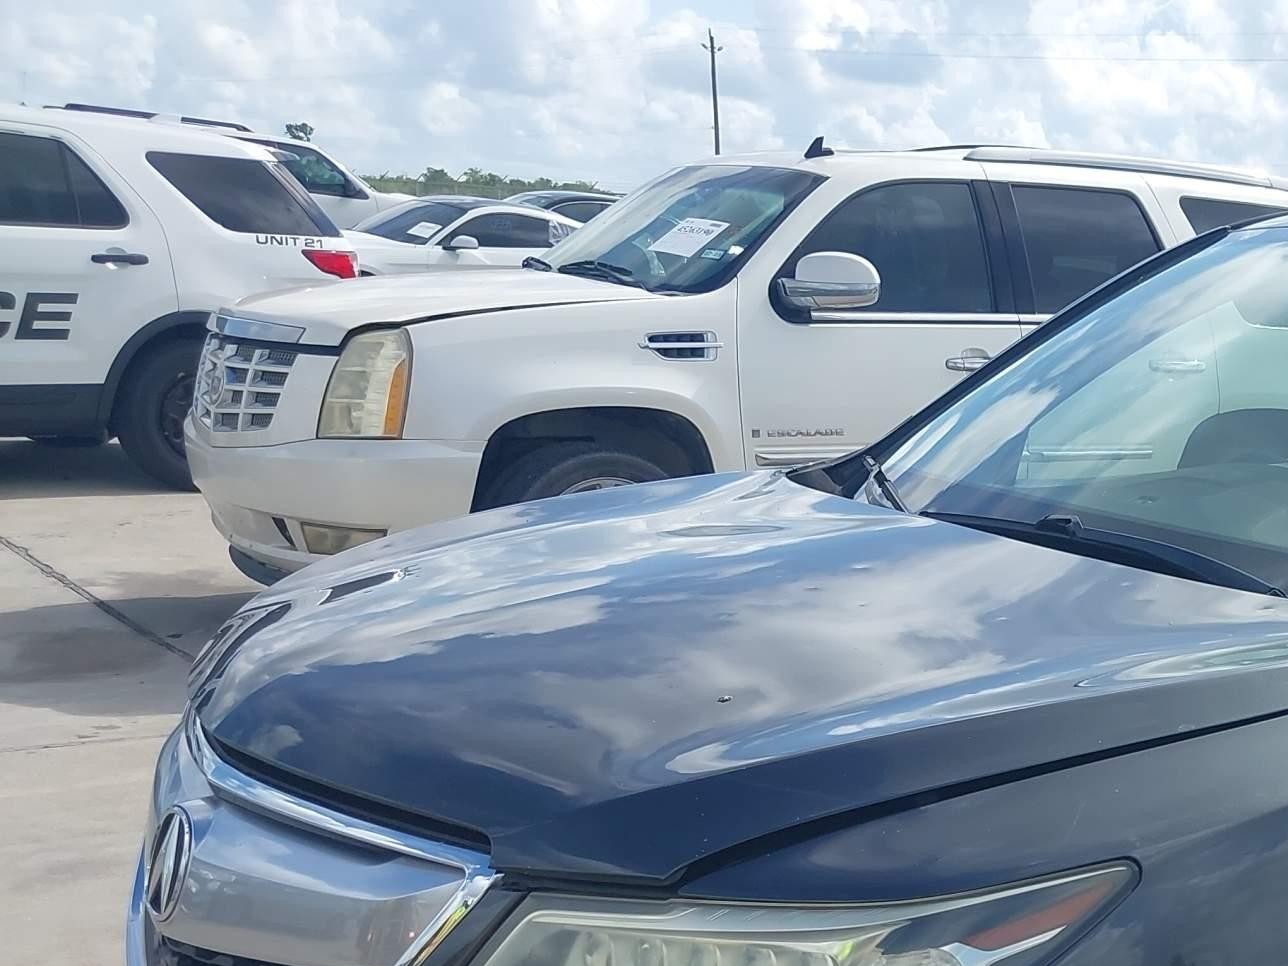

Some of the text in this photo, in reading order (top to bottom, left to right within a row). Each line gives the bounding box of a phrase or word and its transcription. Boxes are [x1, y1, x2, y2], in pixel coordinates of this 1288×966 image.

[255, 234, 323, 249] UNIT 21
[766, 428, 845, 438] ESCALADE
